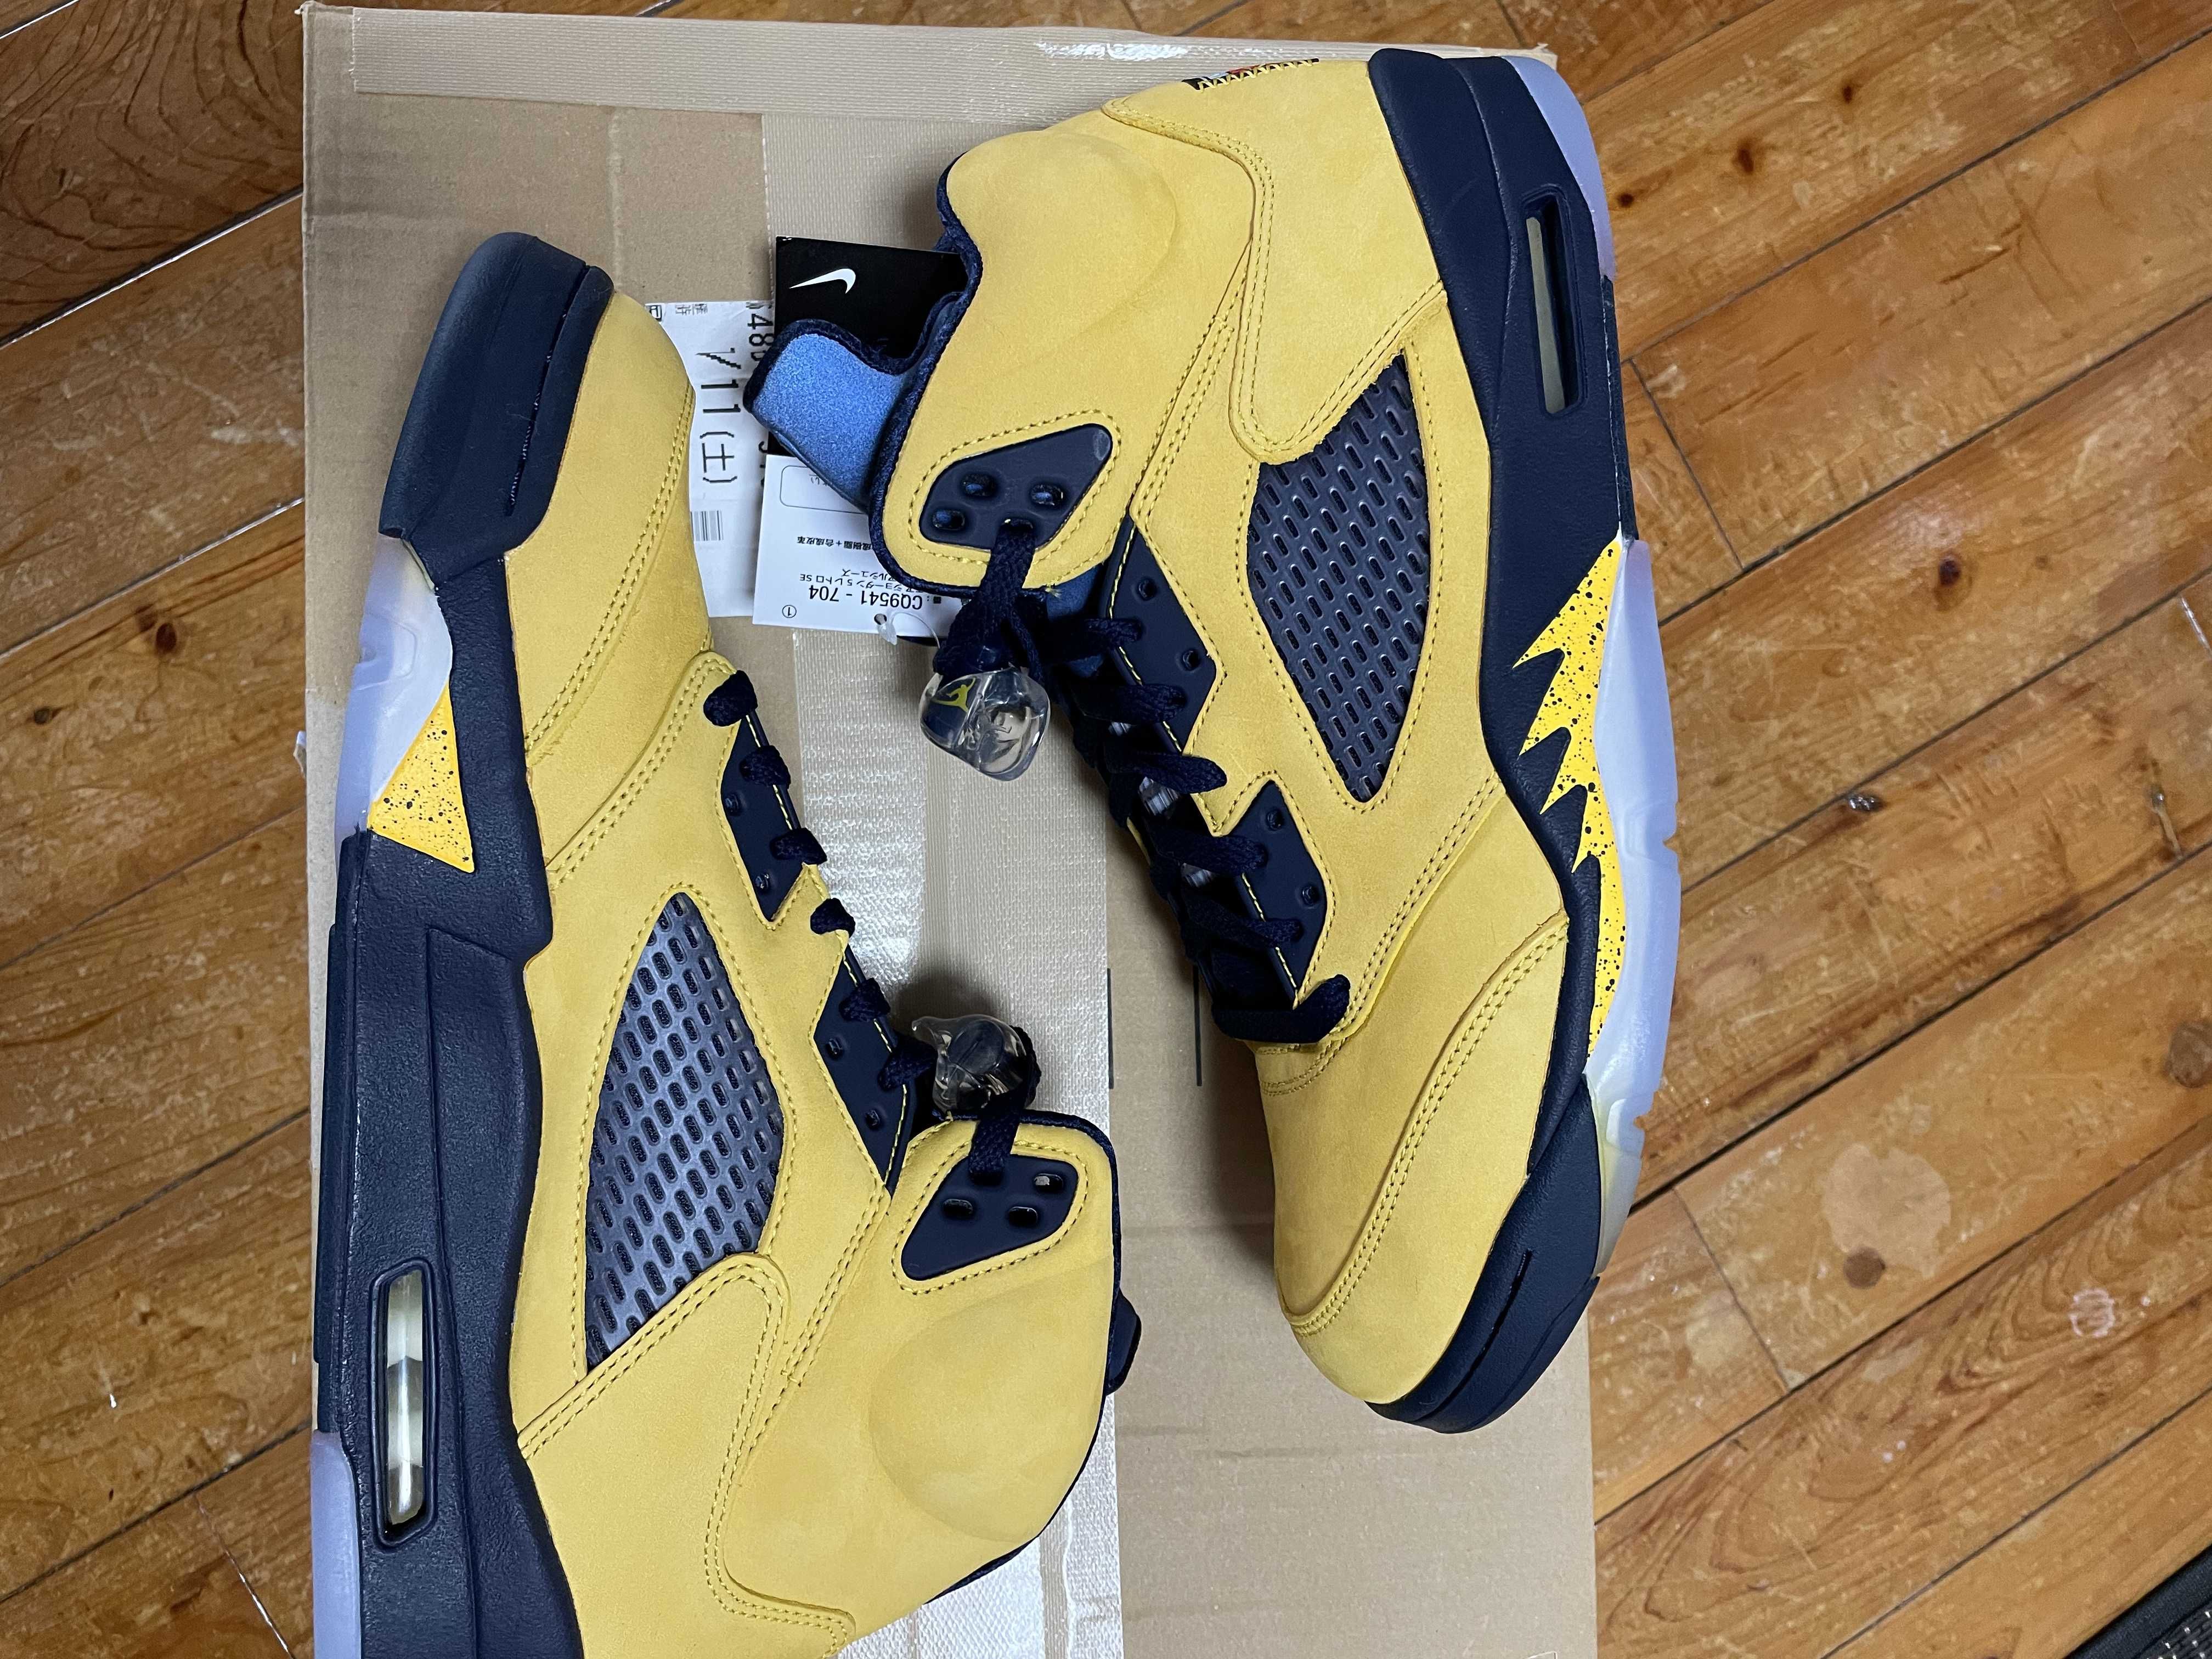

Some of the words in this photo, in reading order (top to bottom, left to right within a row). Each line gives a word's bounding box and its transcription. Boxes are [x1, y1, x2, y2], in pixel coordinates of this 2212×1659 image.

[816, 575, 843, 585] レトロ
[809, 585, 839, 602] 704
[861, 590, 923, 610] CQ9541
